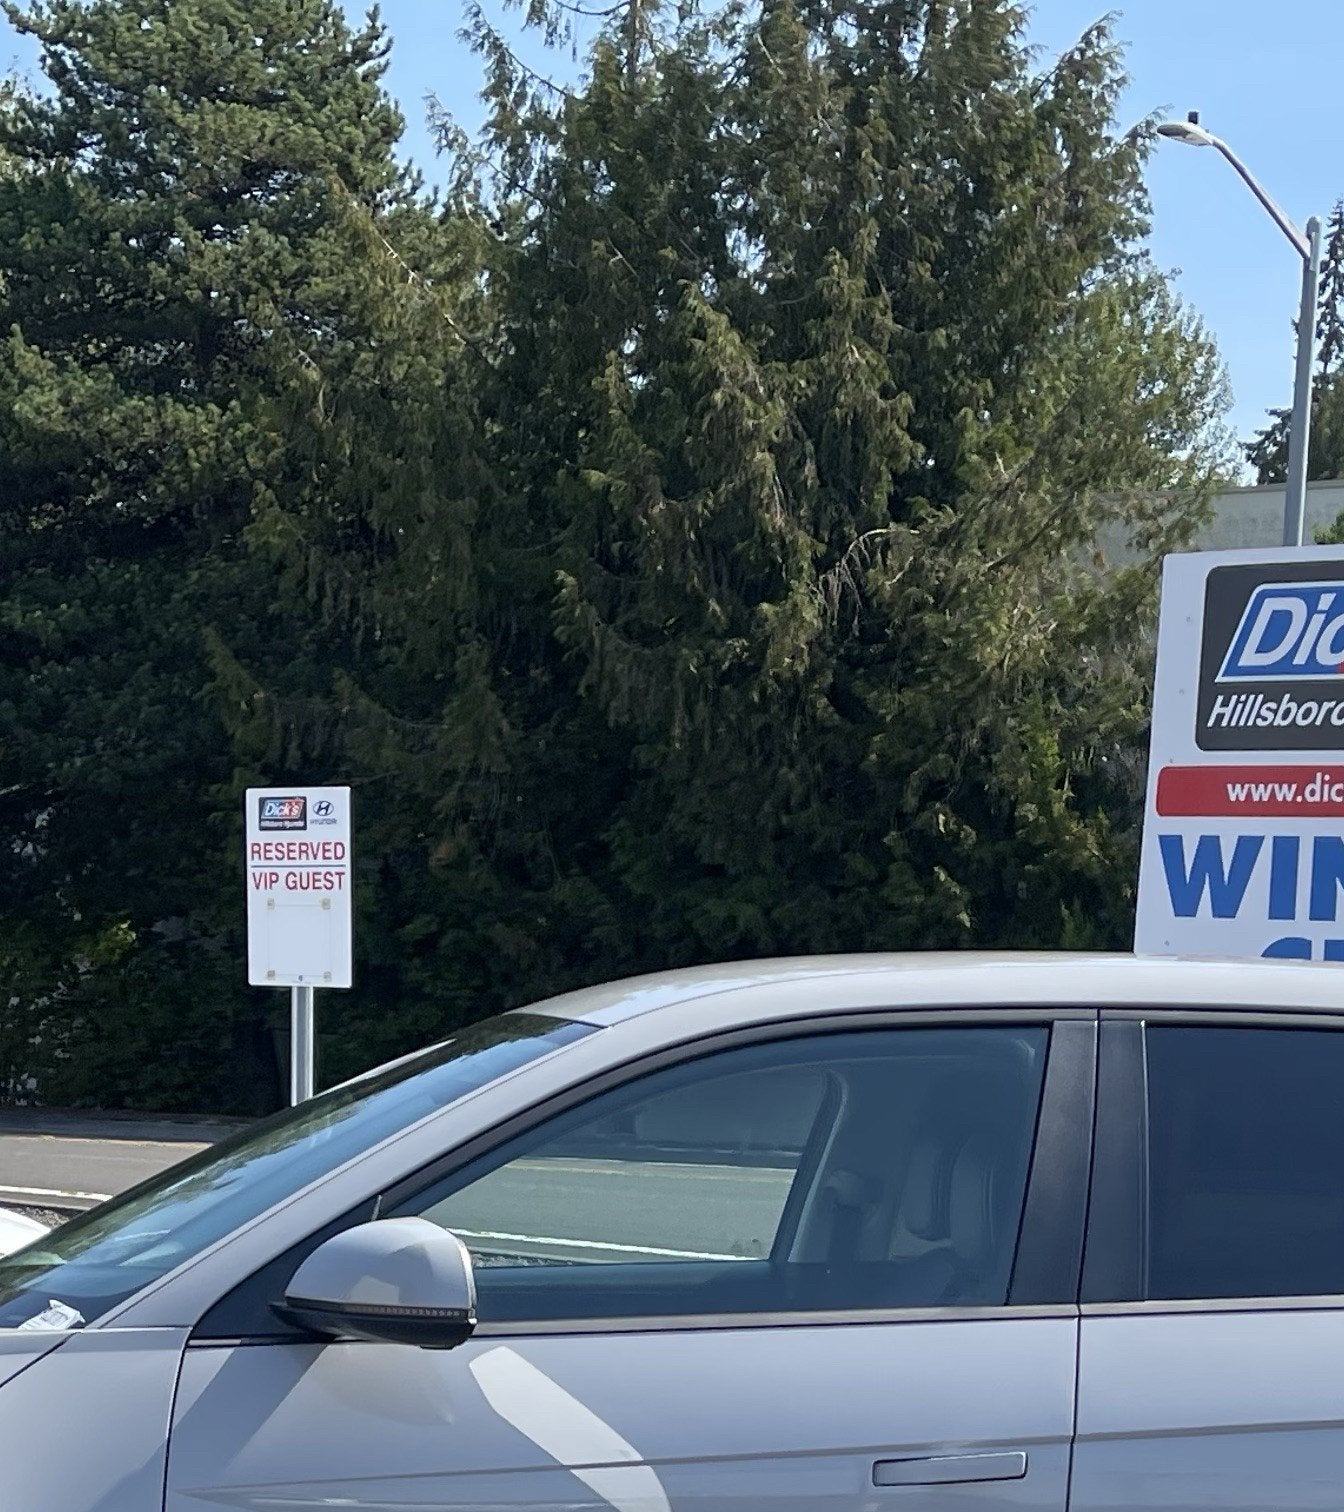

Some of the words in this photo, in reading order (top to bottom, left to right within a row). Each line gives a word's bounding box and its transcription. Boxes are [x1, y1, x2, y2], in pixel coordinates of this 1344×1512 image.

[251, 842, 346, 860] RESERVED
[252, 871, 279, 890] VIP
[285, 871, 346, 890] GUEST
